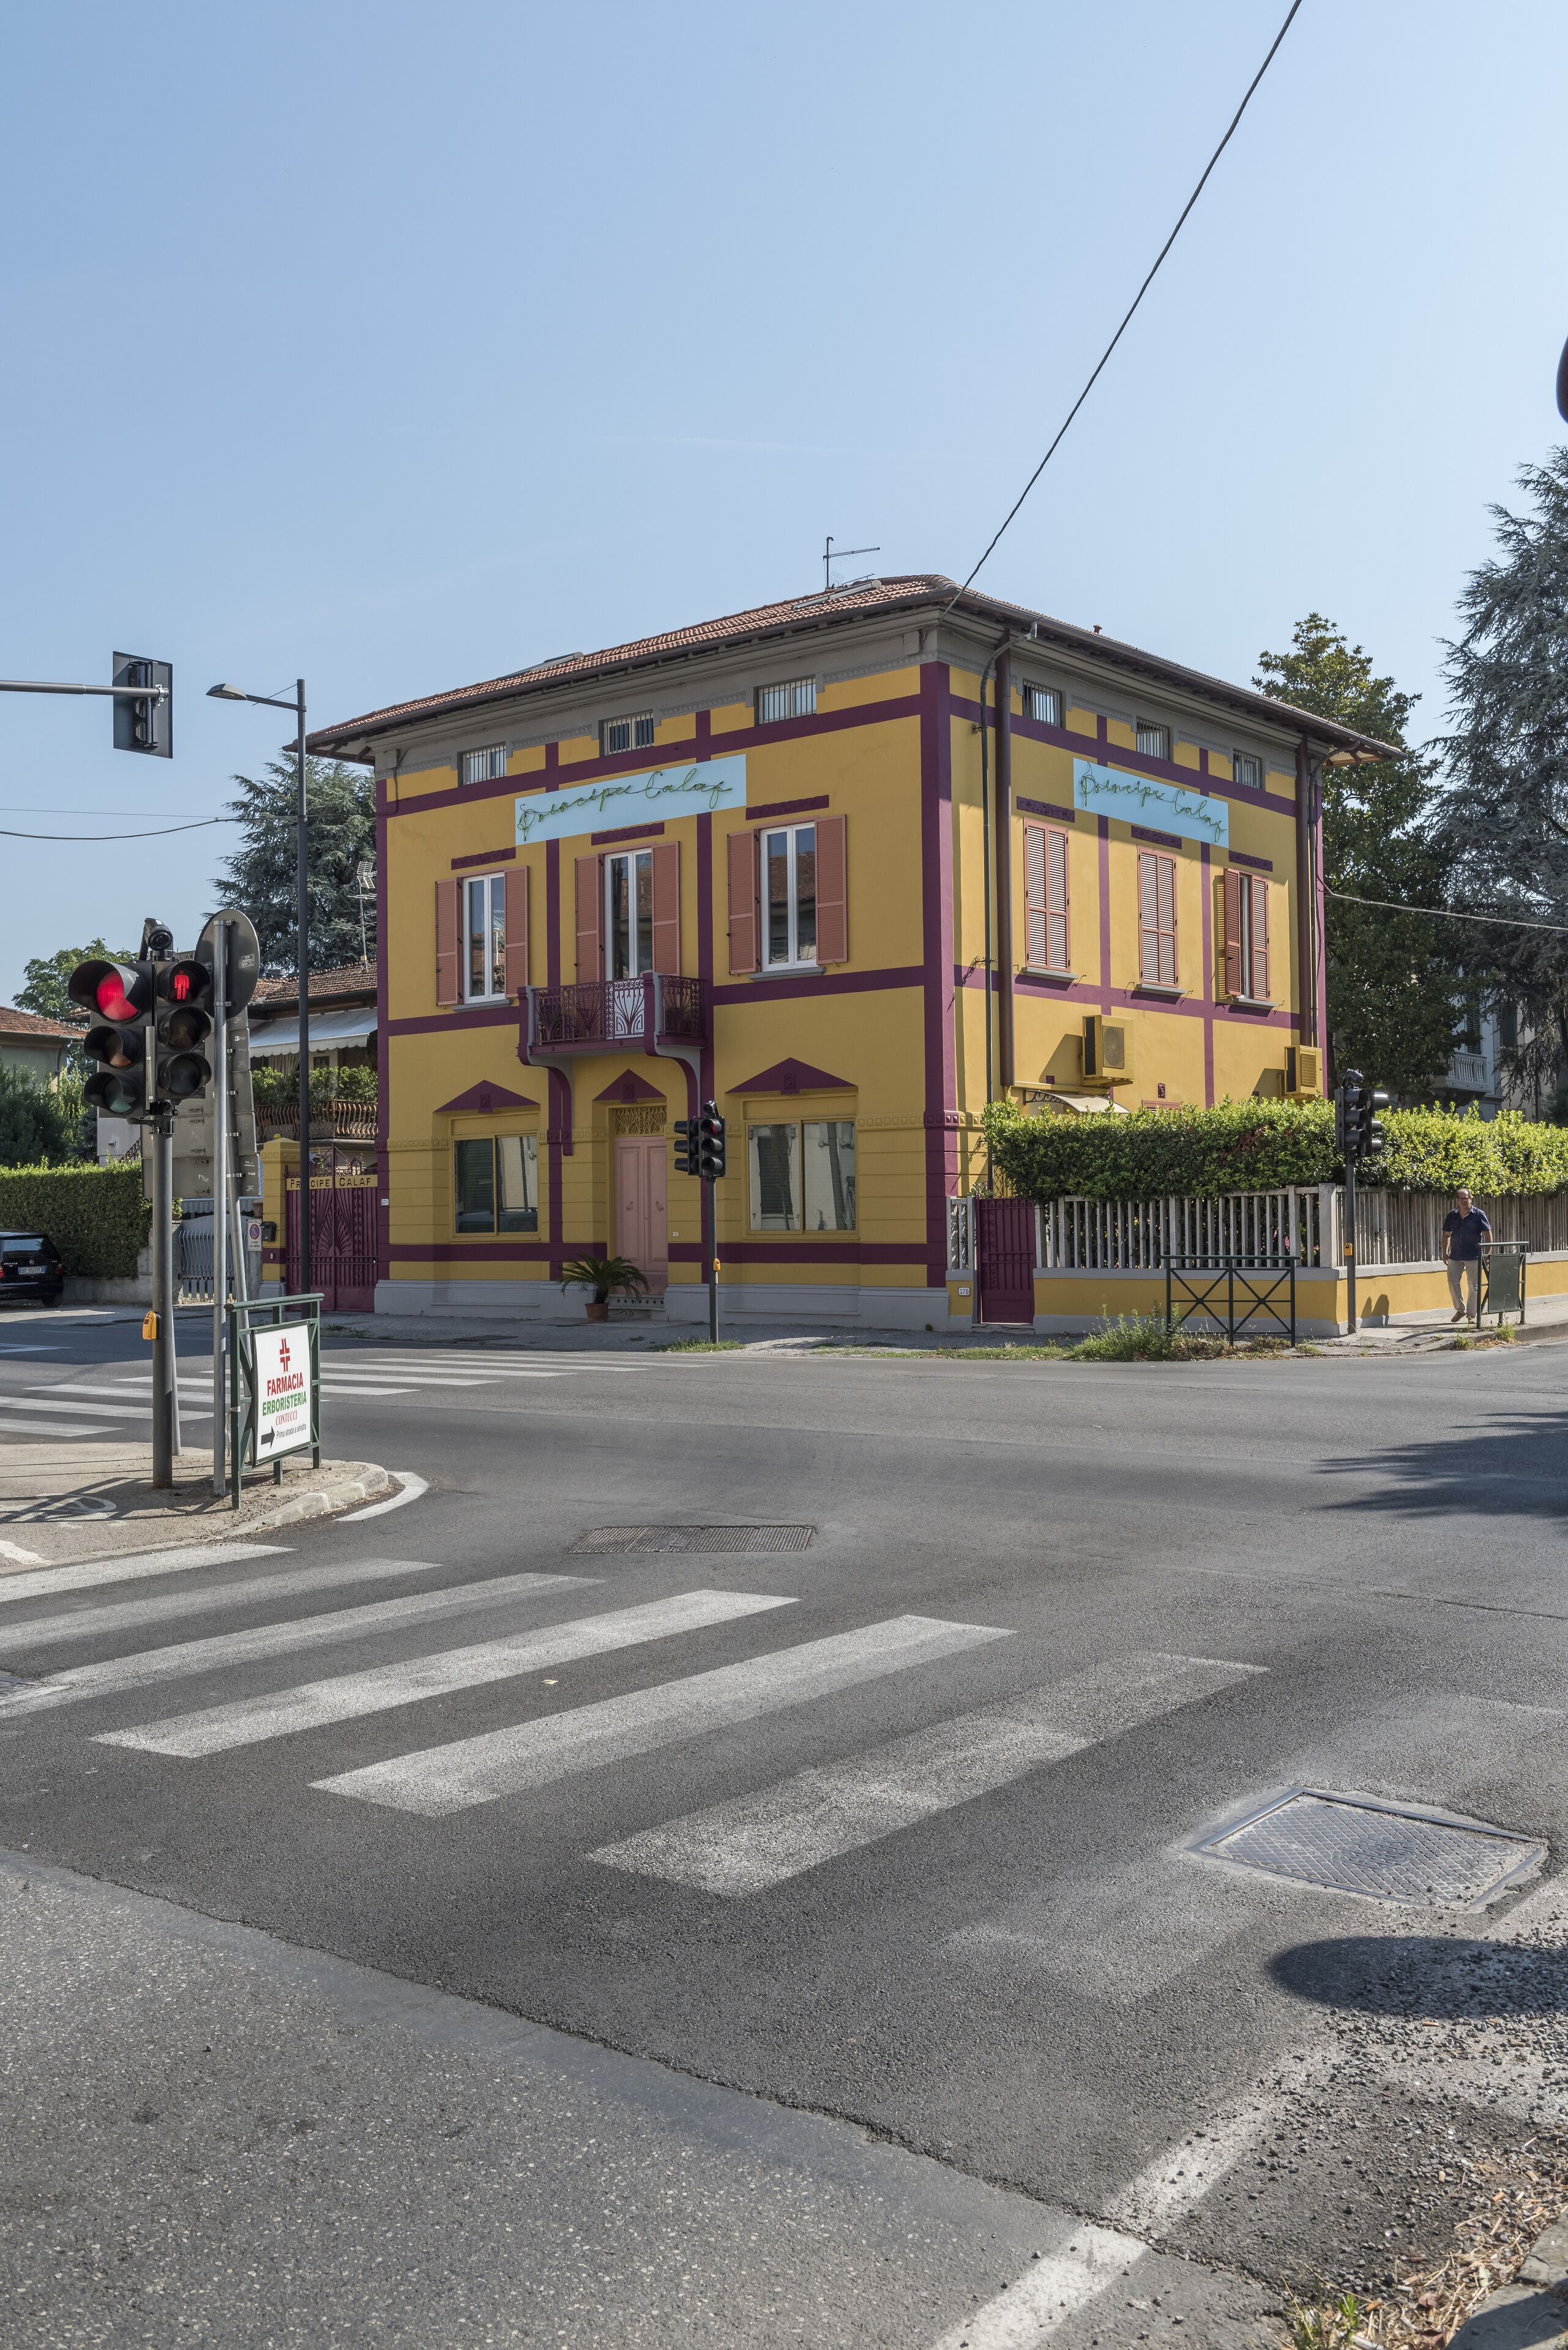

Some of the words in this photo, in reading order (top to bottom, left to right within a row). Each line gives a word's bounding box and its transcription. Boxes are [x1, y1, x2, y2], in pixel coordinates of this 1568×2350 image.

[290, 1179, 330, 1188] PRCIPE
[339, 1177, 371, 1187] CALAF
[267, 1372, 304, 1397] FARMACIA
[263, 1390, 307, 1416] ERBORISTERIA
[275, 1410, 297, 1426] CONTUCCI
[276, 1430, 285, 1439] Prima
